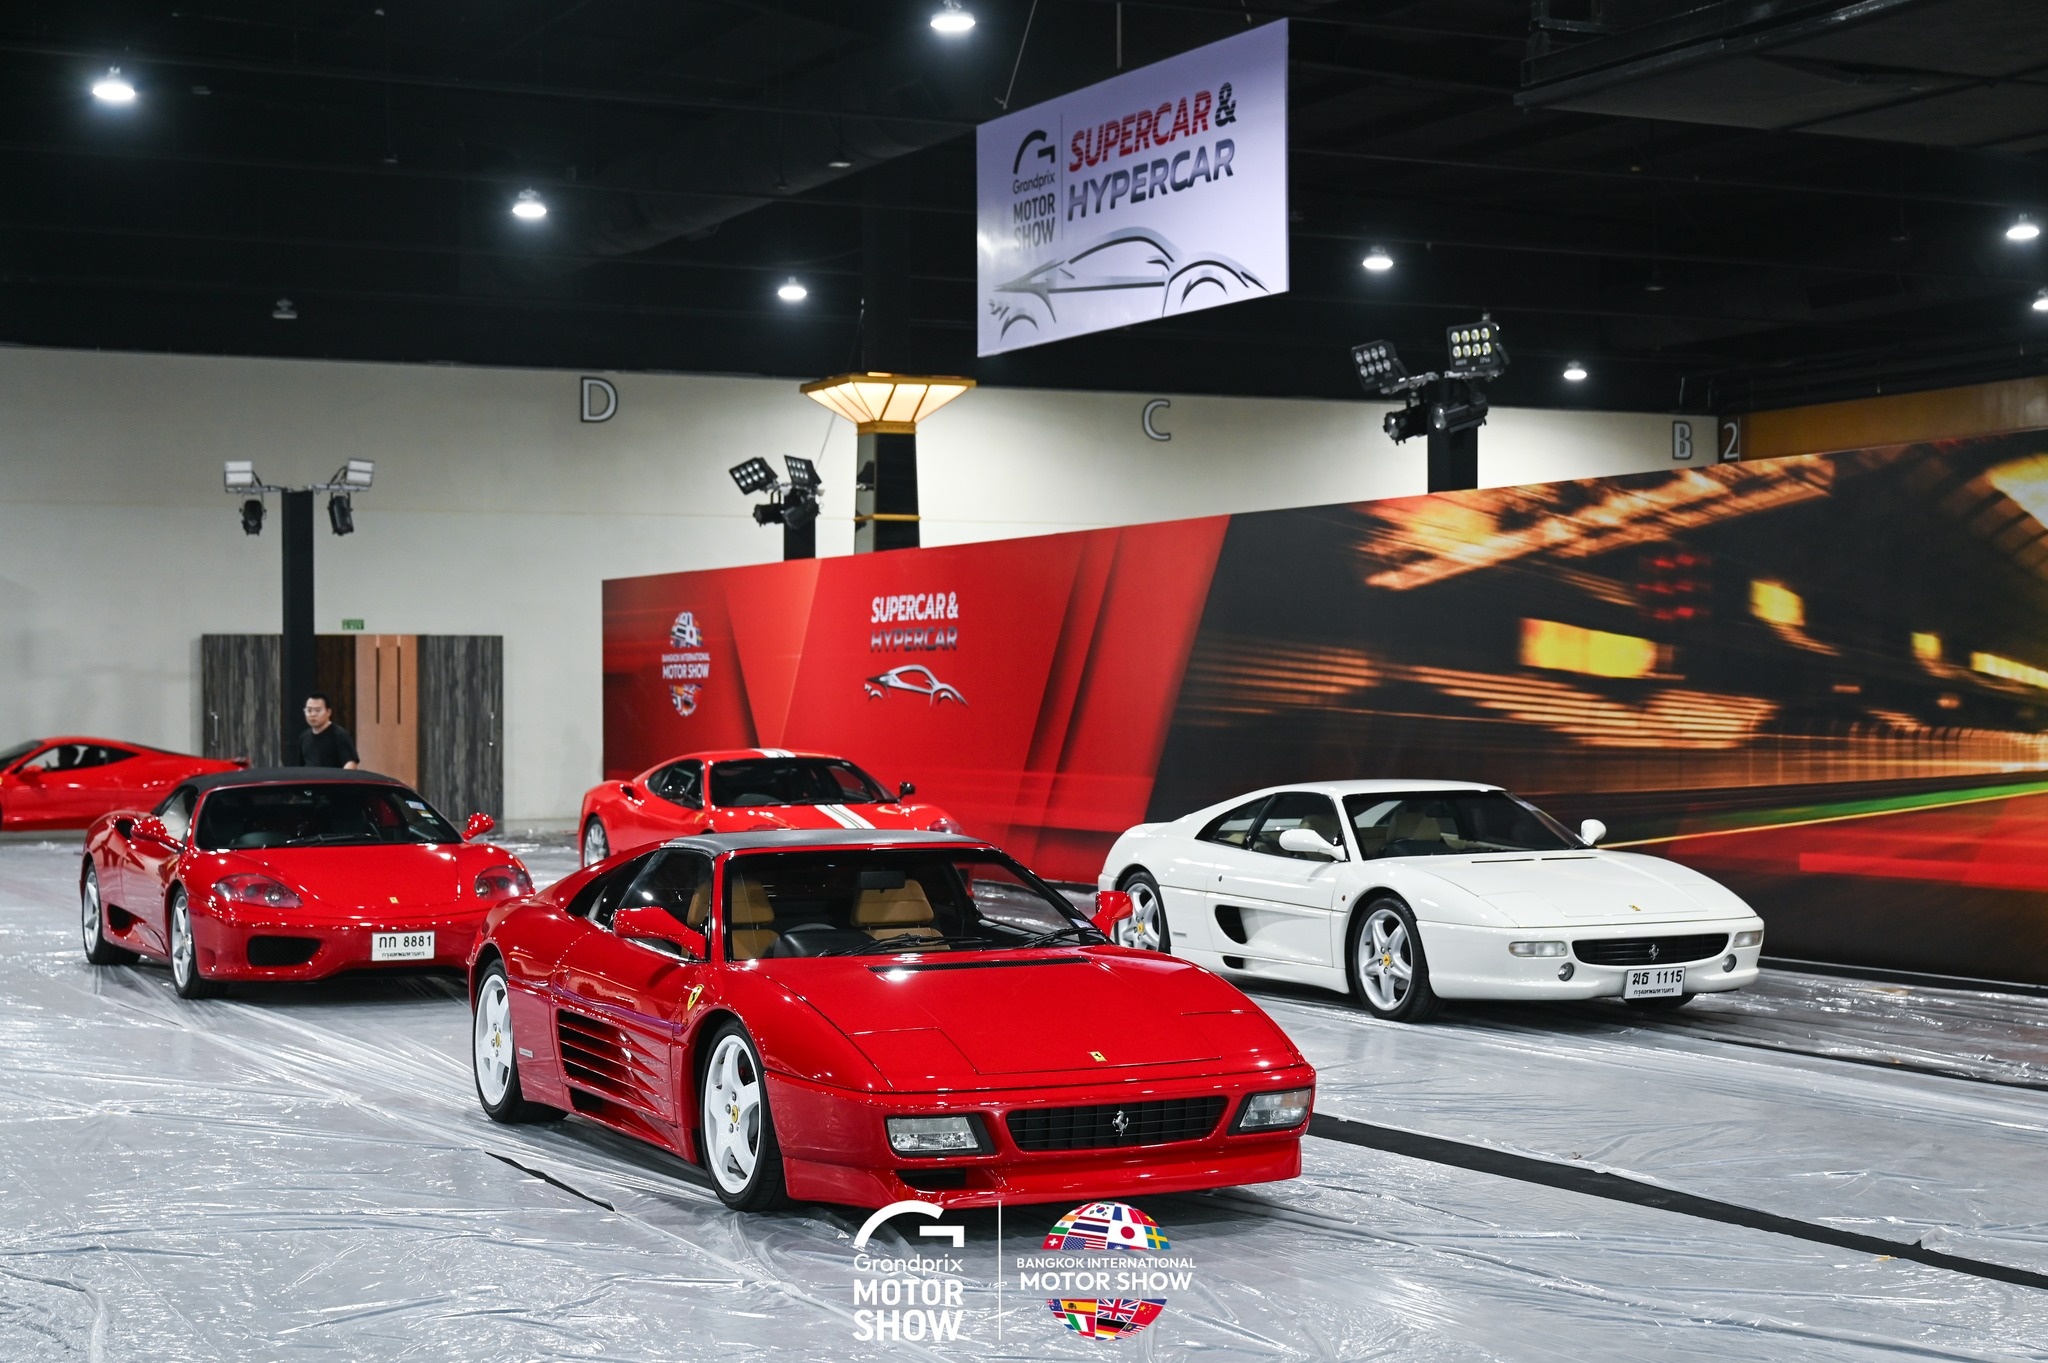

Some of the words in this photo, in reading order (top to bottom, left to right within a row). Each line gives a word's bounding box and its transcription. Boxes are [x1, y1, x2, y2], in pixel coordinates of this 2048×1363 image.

[1012, 170, 1056, 195] Grandprix
[1067, 138, 1235, 222] HYPERCAR
[1013, 192, 1056, 225] MOTOR
[1013, 216, 1056, 252] SHOW
[580, 375, 619, 423] D
[1142, 398, 1172, 442] C
[1672, 420, 1693, 460] B
[1723, 421, 1740, 460] 2
[870, 625, 958, 653] HYPERCAR
[662, 663, 687, 679] MOTOR
[688, 662, 710, 679] SHOW
[379, 936, 397, 949] กก
[403, 934, 431, 948] 8881
[1656, 970, 1683, 984] 1115
